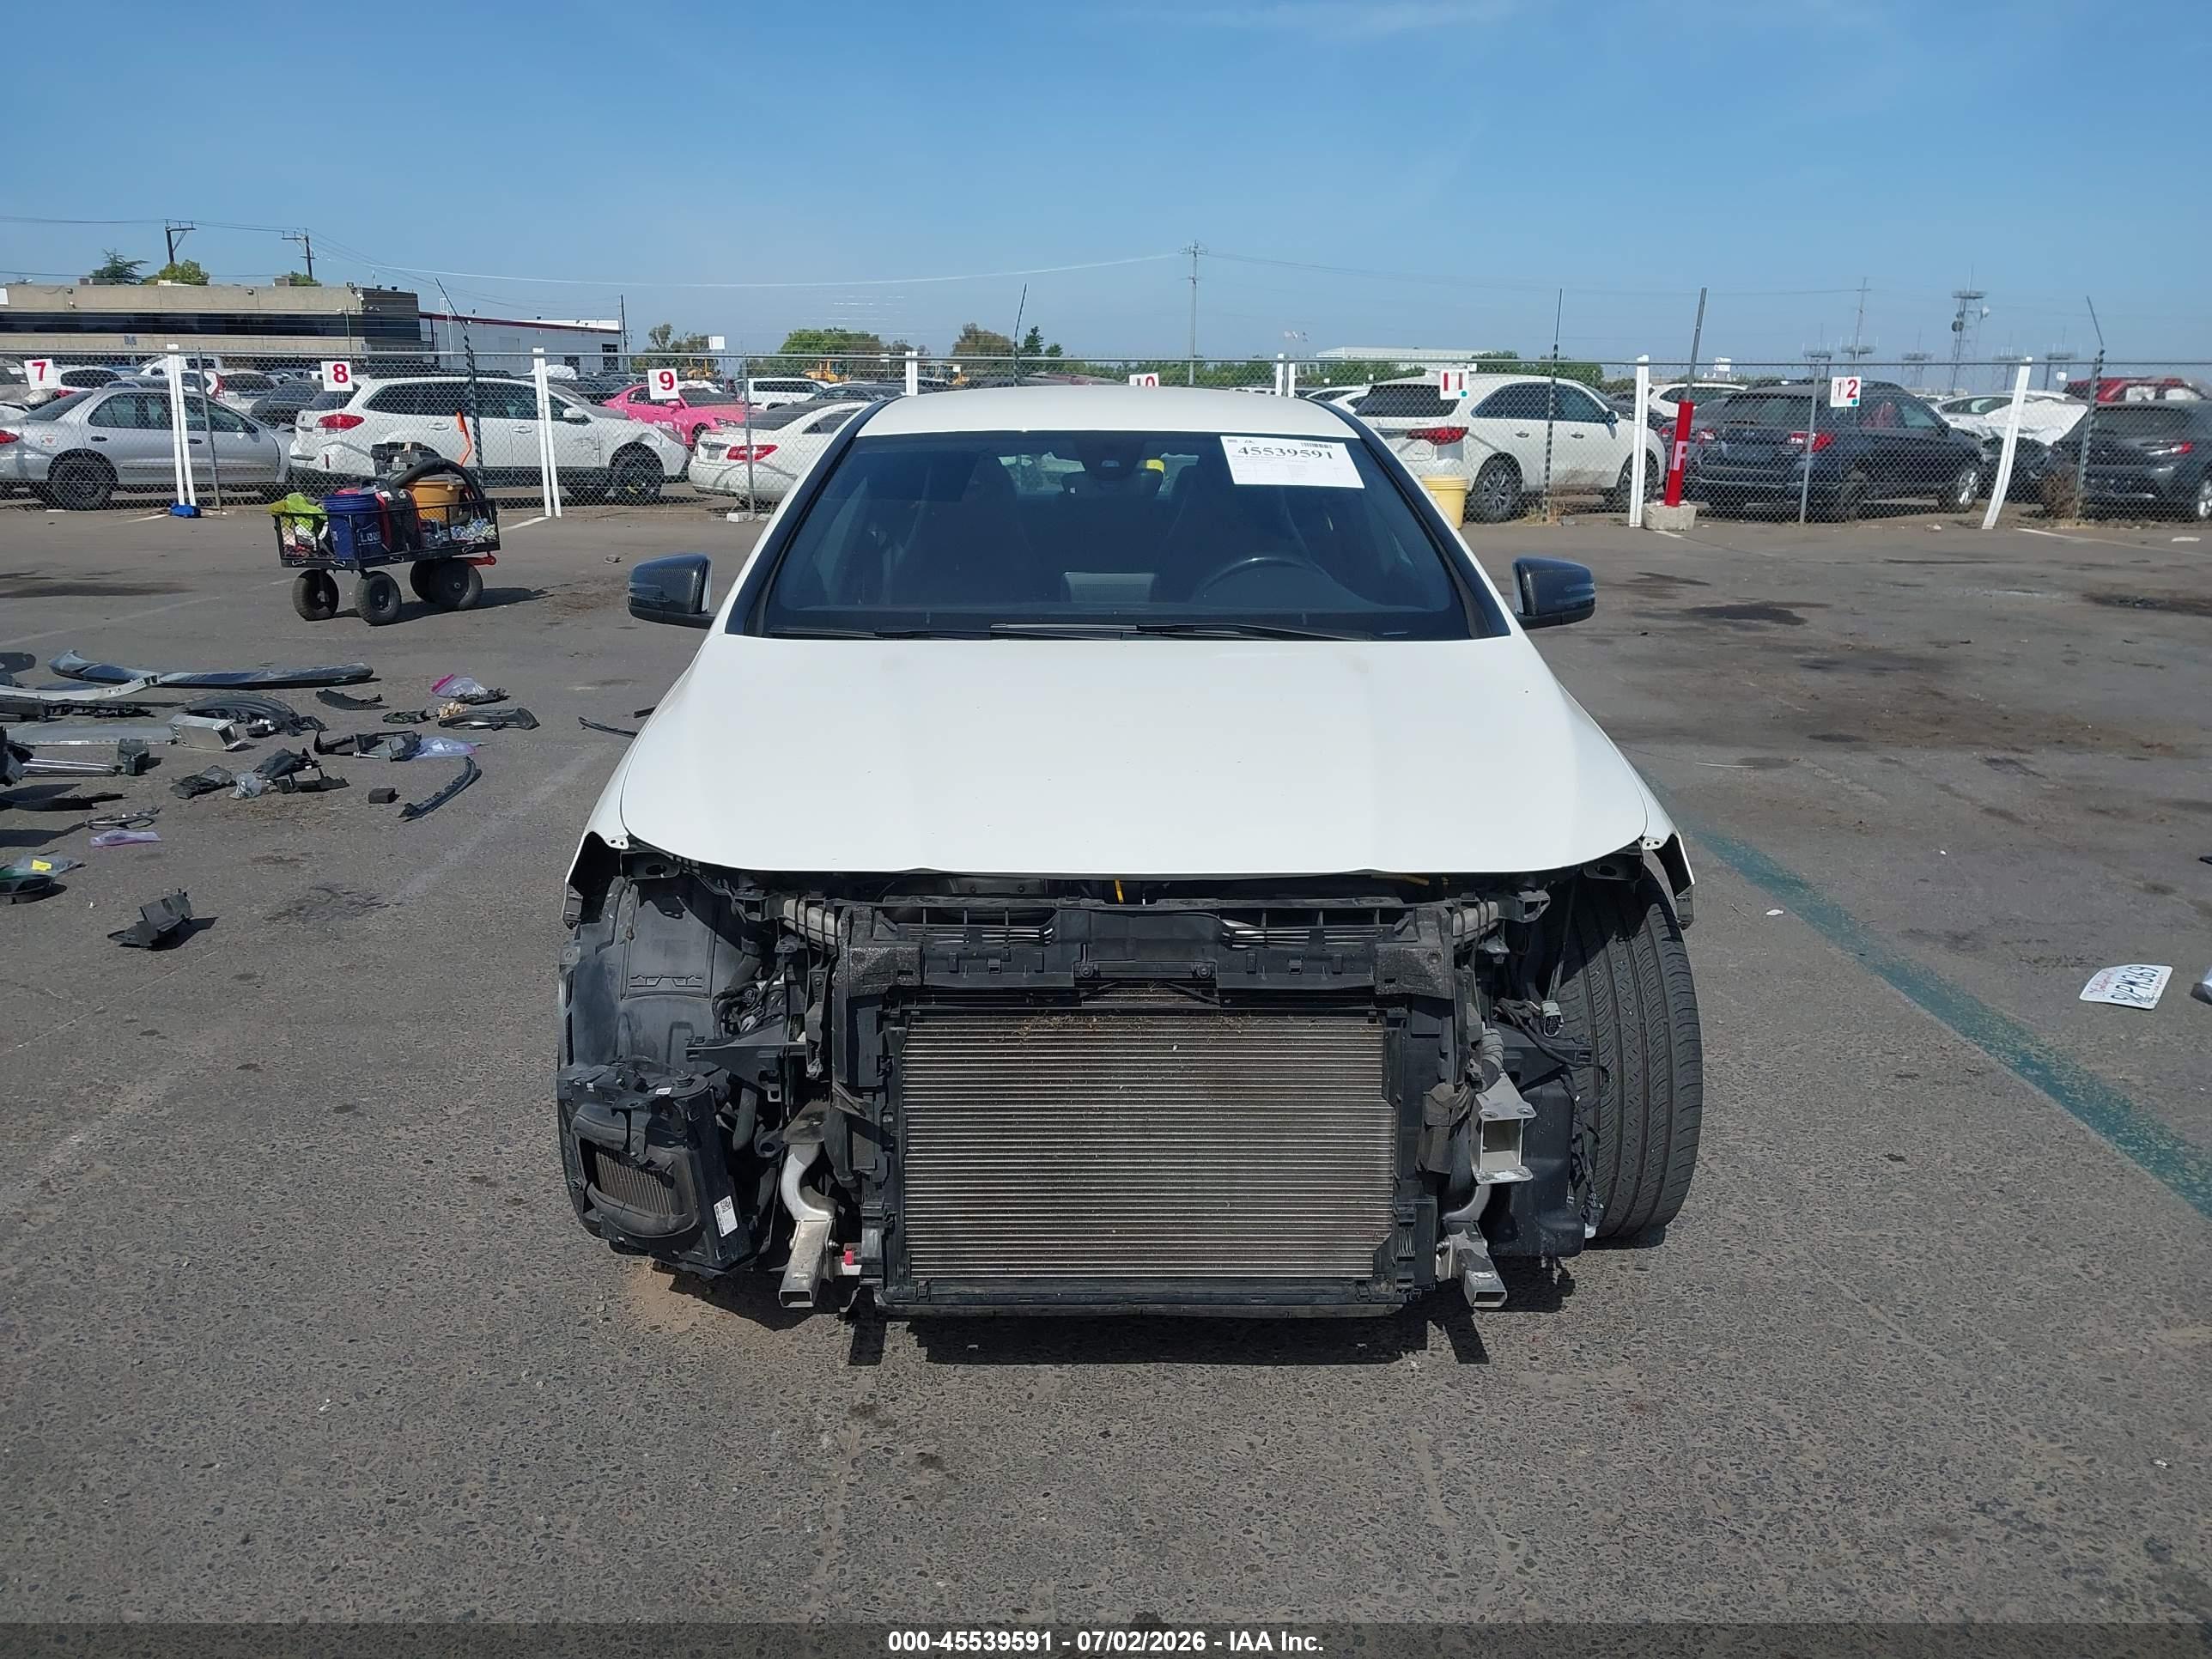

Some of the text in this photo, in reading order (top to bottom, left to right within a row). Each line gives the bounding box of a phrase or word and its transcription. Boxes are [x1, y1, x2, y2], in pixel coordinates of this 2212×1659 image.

[31, 362, 46, 381] 7
[333, 363, 349, 384] 8
[659, 371, 674, 391] 9
[1443, 372, 1463, 392] 11
[1838, 379, 1858, 398] 12
[1237, 446, 1334, 460] 45539591
